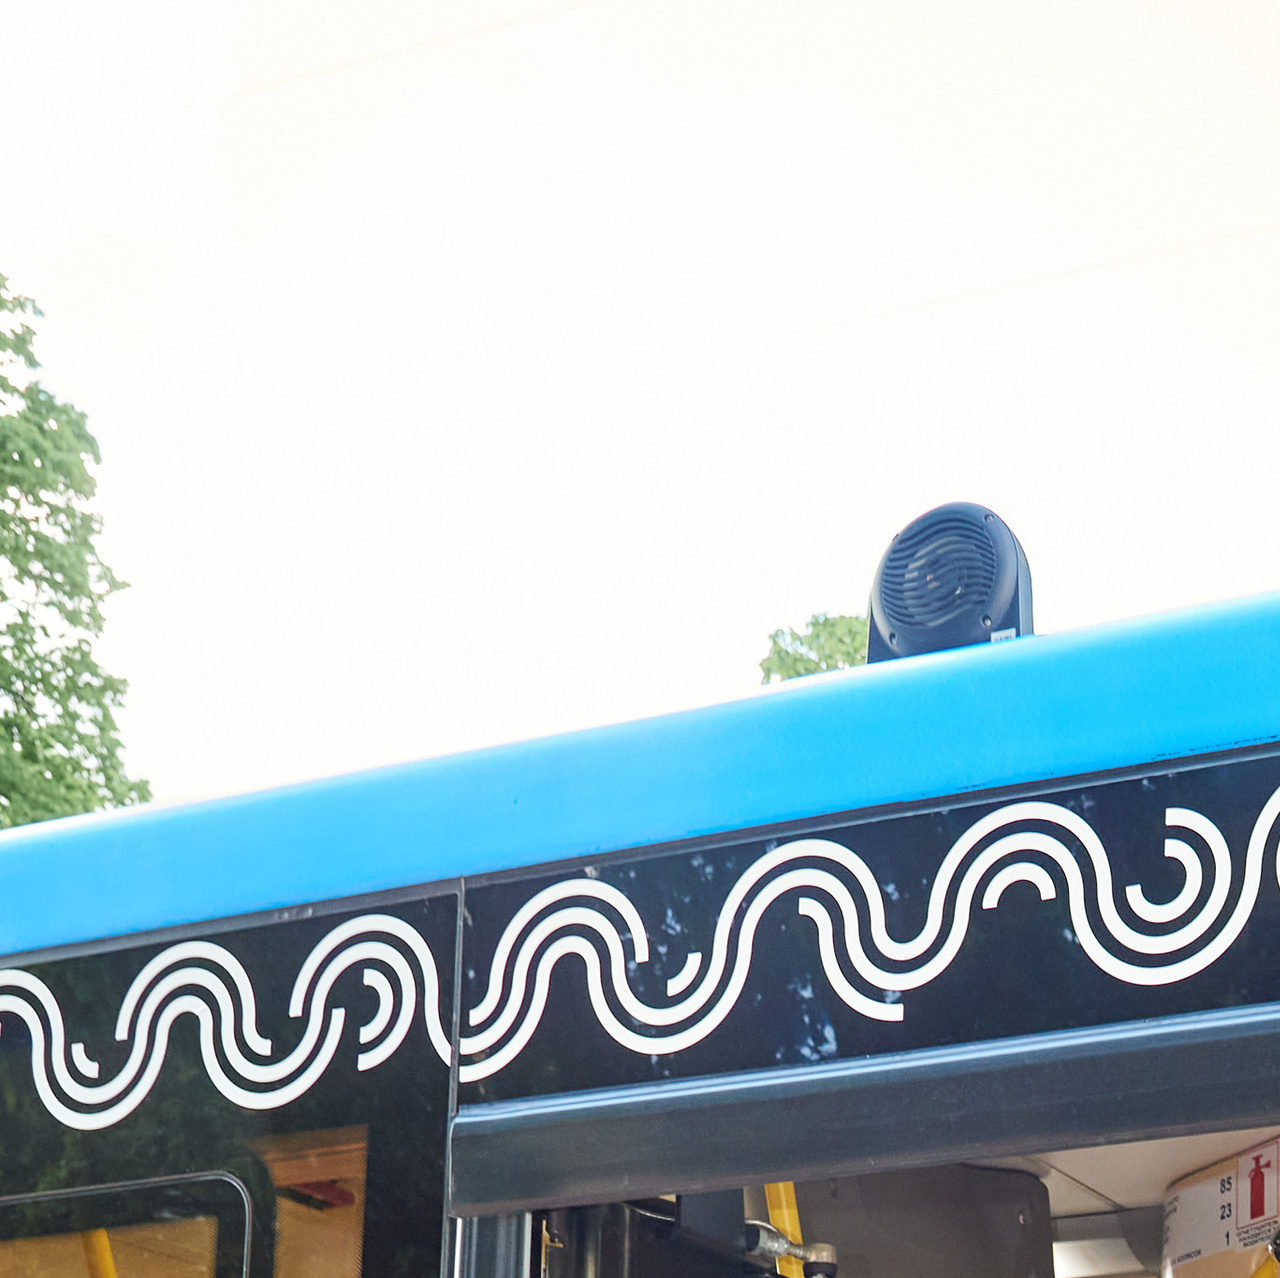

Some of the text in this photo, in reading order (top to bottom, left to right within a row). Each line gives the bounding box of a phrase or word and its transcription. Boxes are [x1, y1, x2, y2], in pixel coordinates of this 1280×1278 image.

[1219, 1176, 1232, 1194] 85
[1219, 1203, 1232, 1221] 23
[1225, 1231, 1230, 1246] 1
